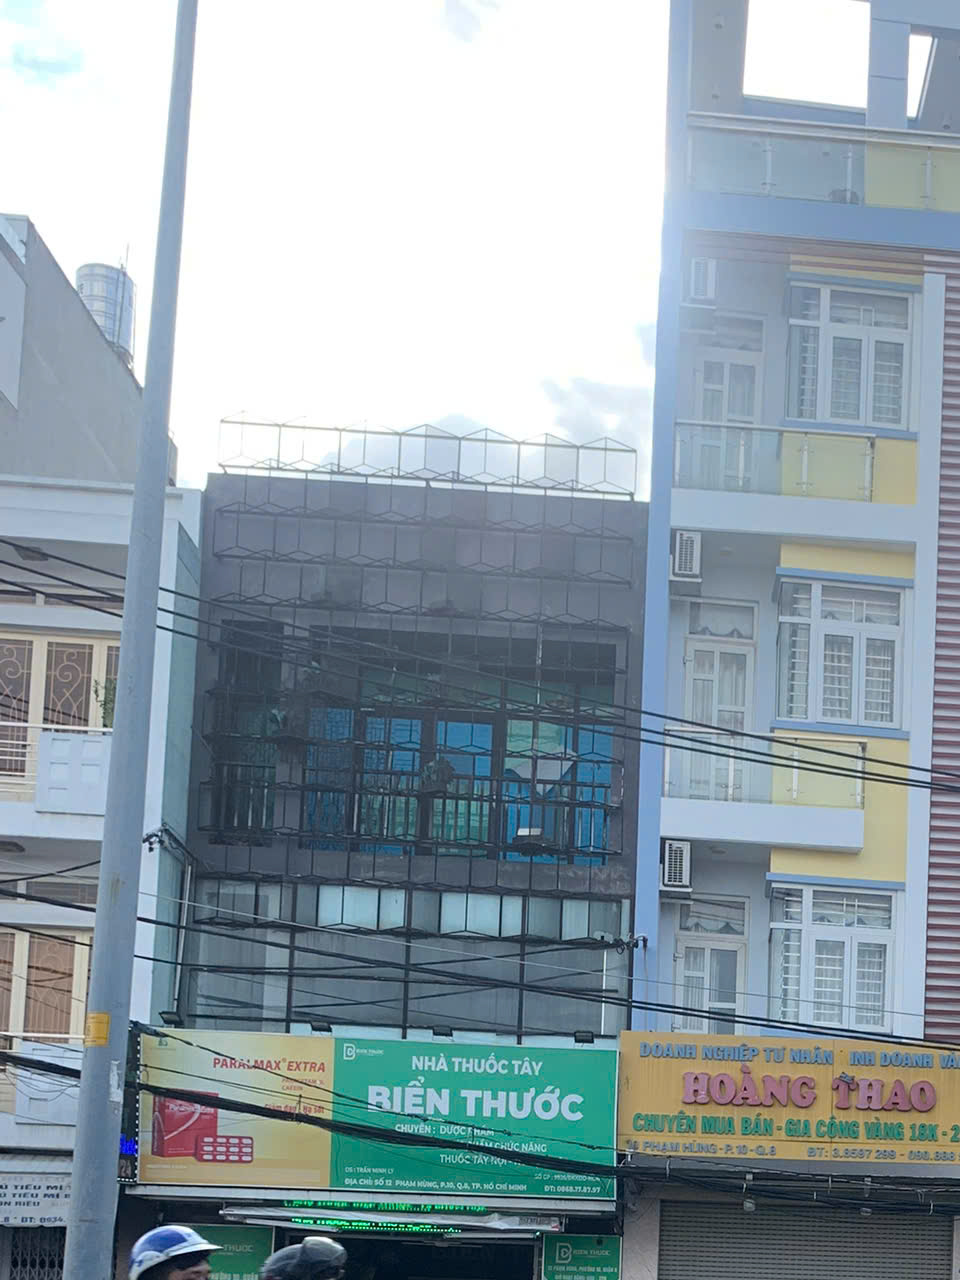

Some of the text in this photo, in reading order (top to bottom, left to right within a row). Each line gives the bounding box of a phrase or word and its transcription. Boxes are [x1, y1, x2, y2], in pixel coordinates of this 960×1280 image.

[412, 1052, 543, 1076] NHÀ THUỐC TÂY
[639, 1041, 697, 1059] DOANH
[789, 1045, 833, 1065] NHÂN
[880, 1050, 934, 1068] DOANH
[287, 1060, 326, 1073] EXTRA
[682, 1063, 817, 1109] HOÀNG
[368, 1076, 584, 1121] BIỂN THƯỚC
[632, 1110, 697, 1134] CHUYÊN
[701, 1116, 736, 1135] MUA
[741, 1112, 774, 1137] BÁN
[785, 1118, 811, 1138] GIA
[816, 1113, 859, 1139] CÔNG
[864, 1116, 905, 1141] VÀNG
[909, 1123, 939, 1142] 18K
